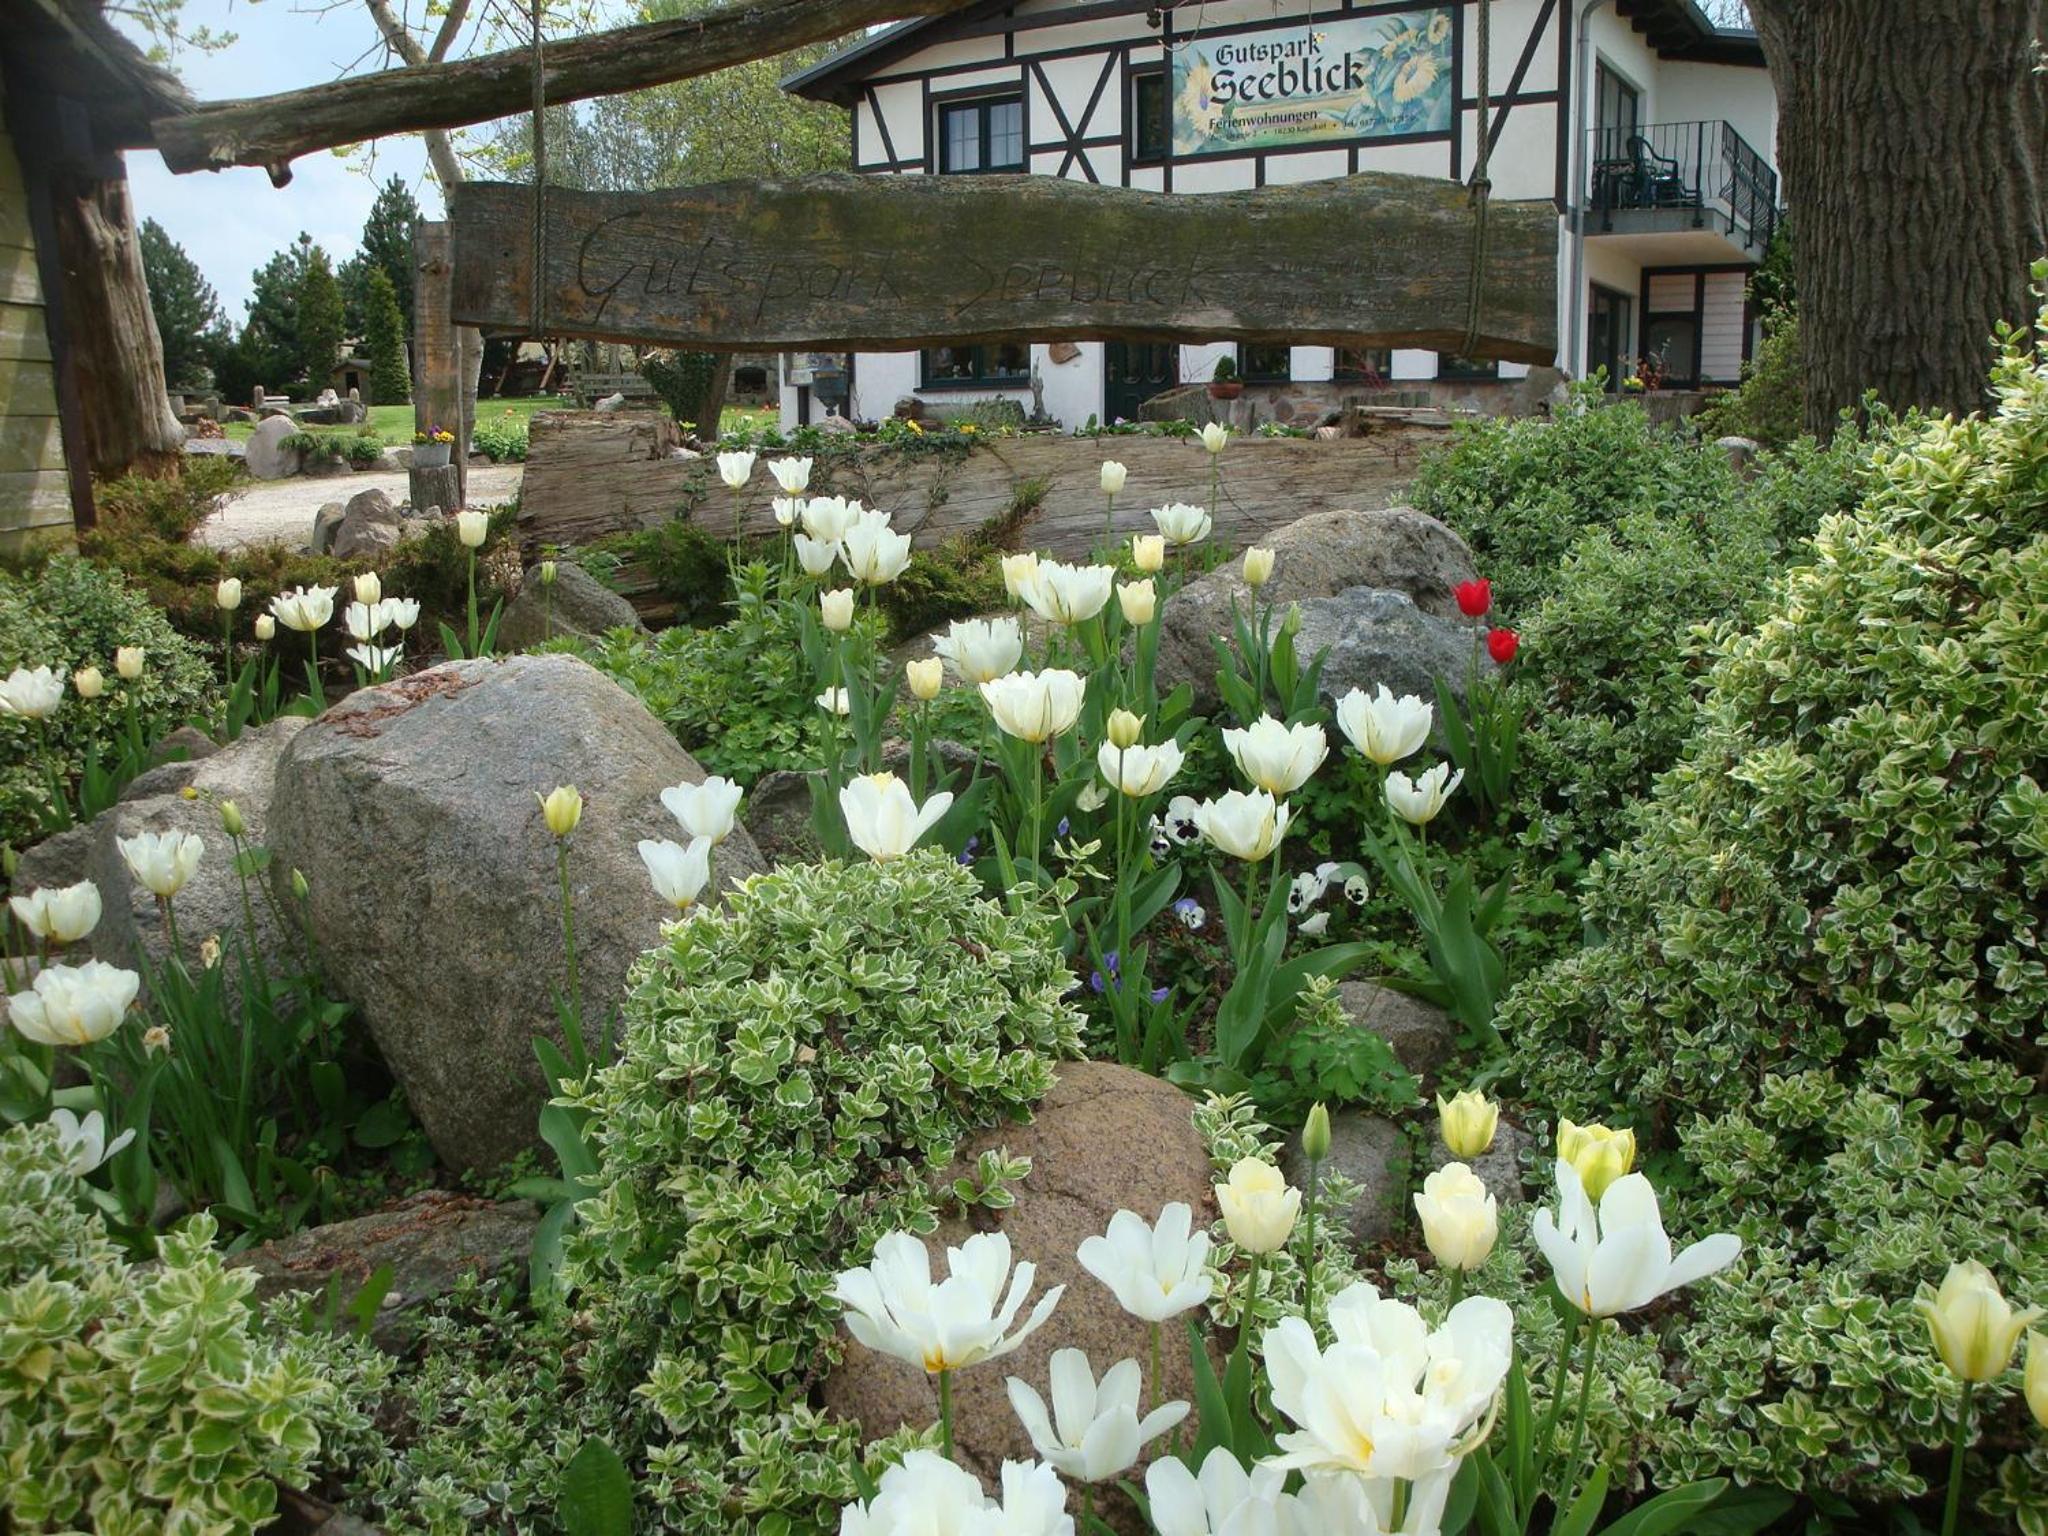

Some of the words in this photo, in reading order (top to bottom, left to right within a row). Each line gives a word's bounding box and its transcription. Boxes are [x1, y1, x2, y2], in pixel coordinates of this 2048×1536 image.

[1215, 32, 1321, 66] Gutspark
[1210, 52, 1365, 104] Seeblick
[1208, 110, 1318, 130] Ferienwohnungen
